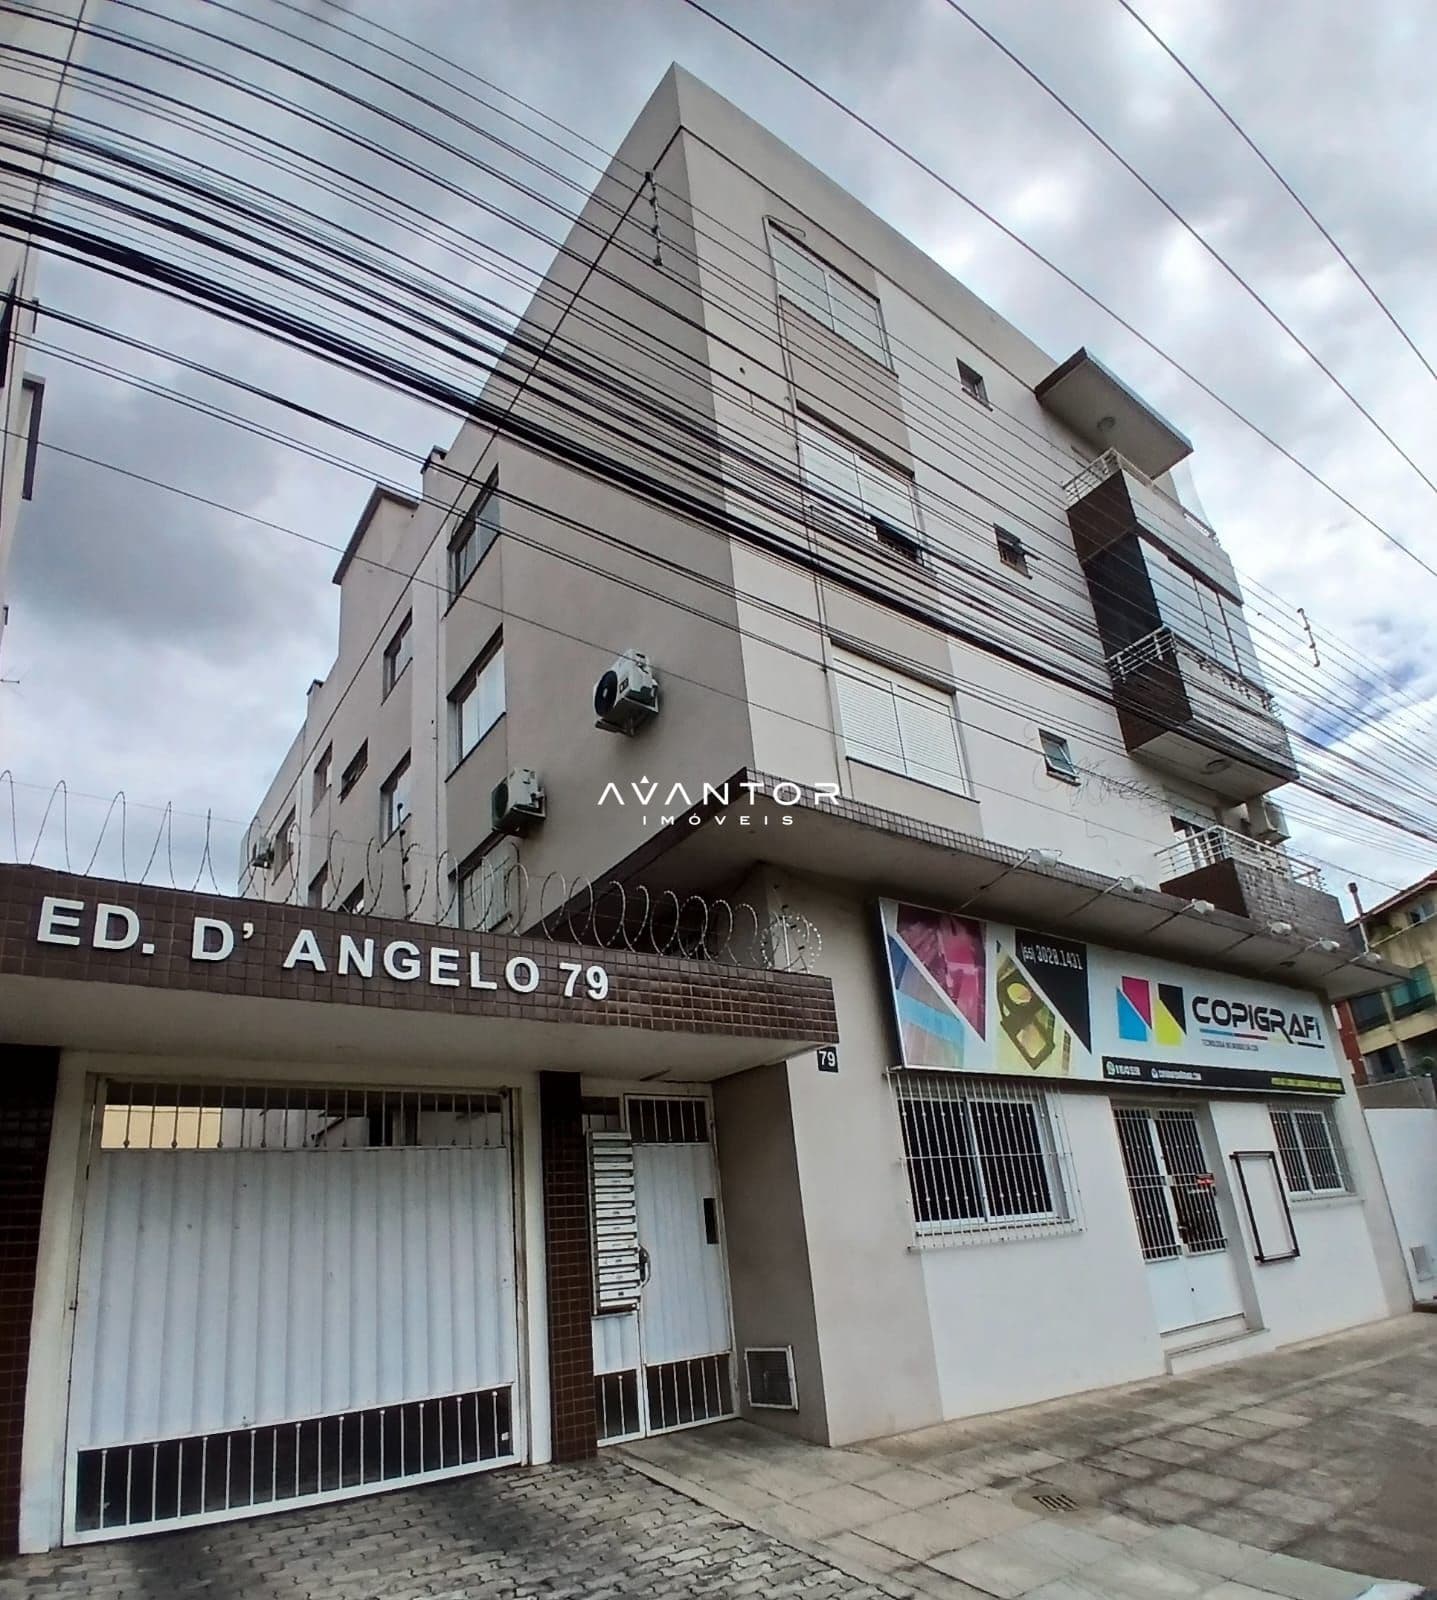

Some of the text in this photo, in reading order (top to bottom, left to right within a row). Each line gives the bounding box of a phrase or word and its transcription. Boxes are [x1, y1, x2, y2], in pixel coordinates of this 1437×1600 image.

[37, 896, 156, 956] ED.
[283, 928, 540, 994] ANGELO
[558, 961, 609, 1001] 79
[1192, 995, 1322, 1044] COPIGRAFI
[819, 1050, 836, 1067] 79
